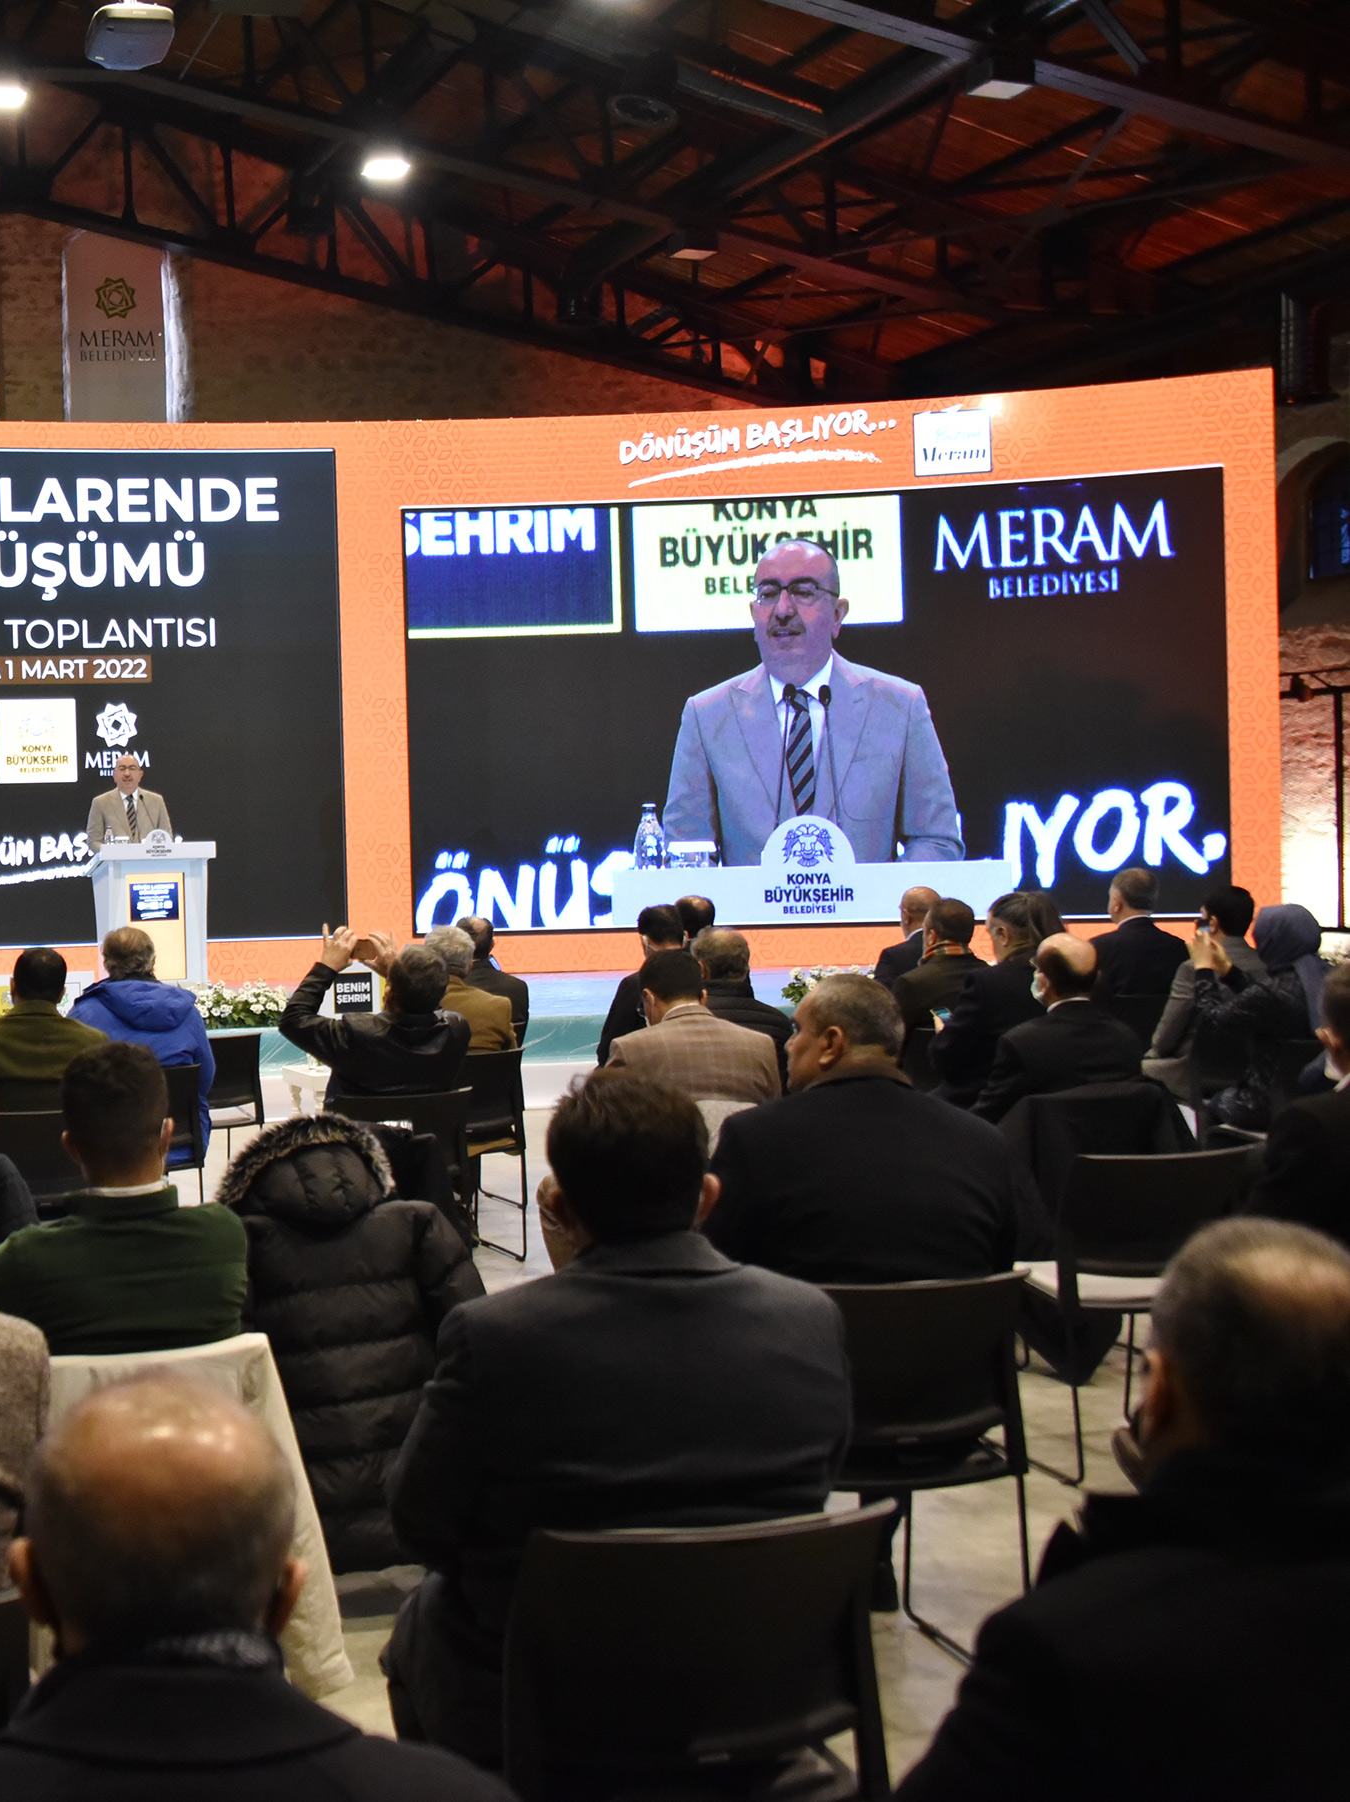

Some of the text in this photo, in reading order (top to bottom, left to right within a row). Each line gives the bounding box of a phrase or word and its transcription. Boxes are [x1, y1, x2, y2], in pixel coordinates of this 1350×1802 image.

[79, 330, 155, 348] MERAM
[619, 424, 741, 465] DÖNÜŞÜM
[0, 477, 280, 523] LARENDE
[934, 498, 1177, 573] MERAM
[4, 616, 217, 650] TOPLANTISI
[5, 659, 14, 680] 1
[21, 658, 89, 680] MART
[93, 657, 148, 680] 2022
[22, 744, 53, 753] KONYA
[786, 872, 832, 886] KONYA
[764, 885, 855, 905] BÜYÜKŞEHİR
[782, 902, 837, 915] BELEDİYESİ
